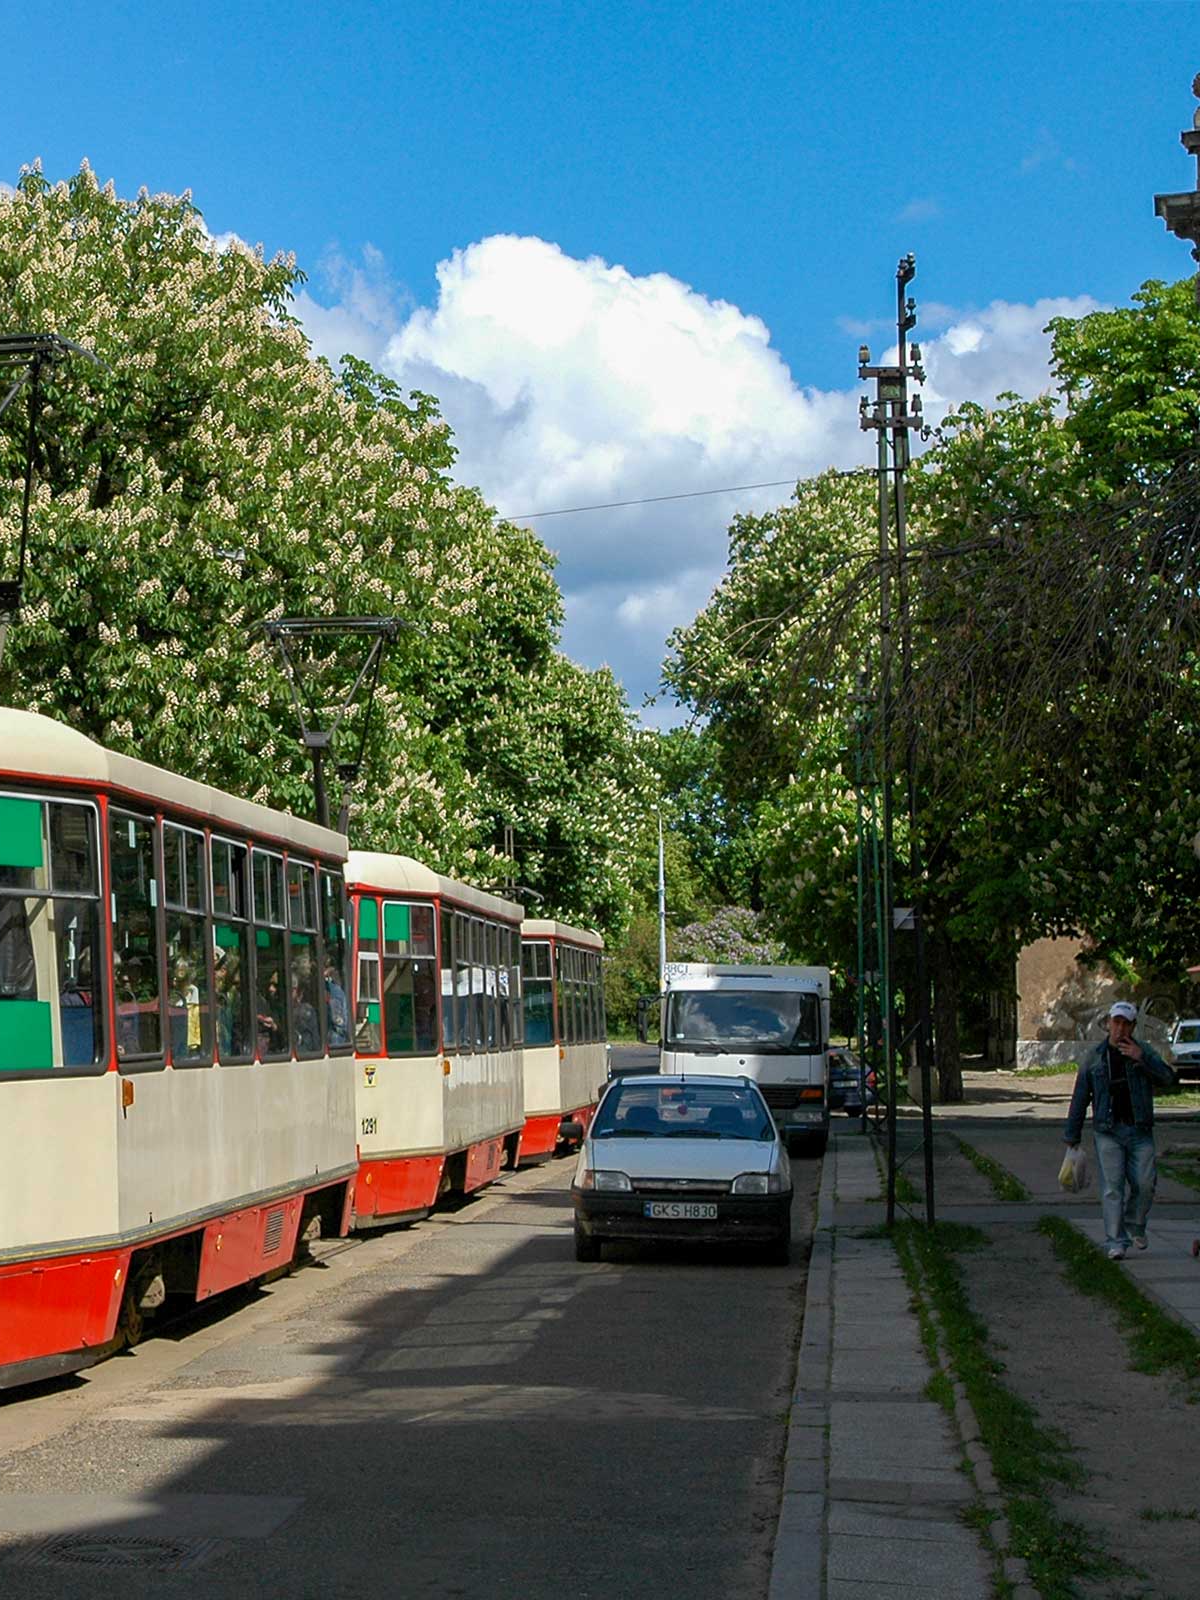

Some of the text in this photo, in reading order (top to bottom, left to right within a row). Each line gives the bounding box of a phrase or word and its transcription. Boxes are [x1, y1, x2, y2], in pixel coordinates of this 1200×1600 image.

[361, 1118, 377, 1135] 1291
[652, 1204, 717, 1218] GKS H830
